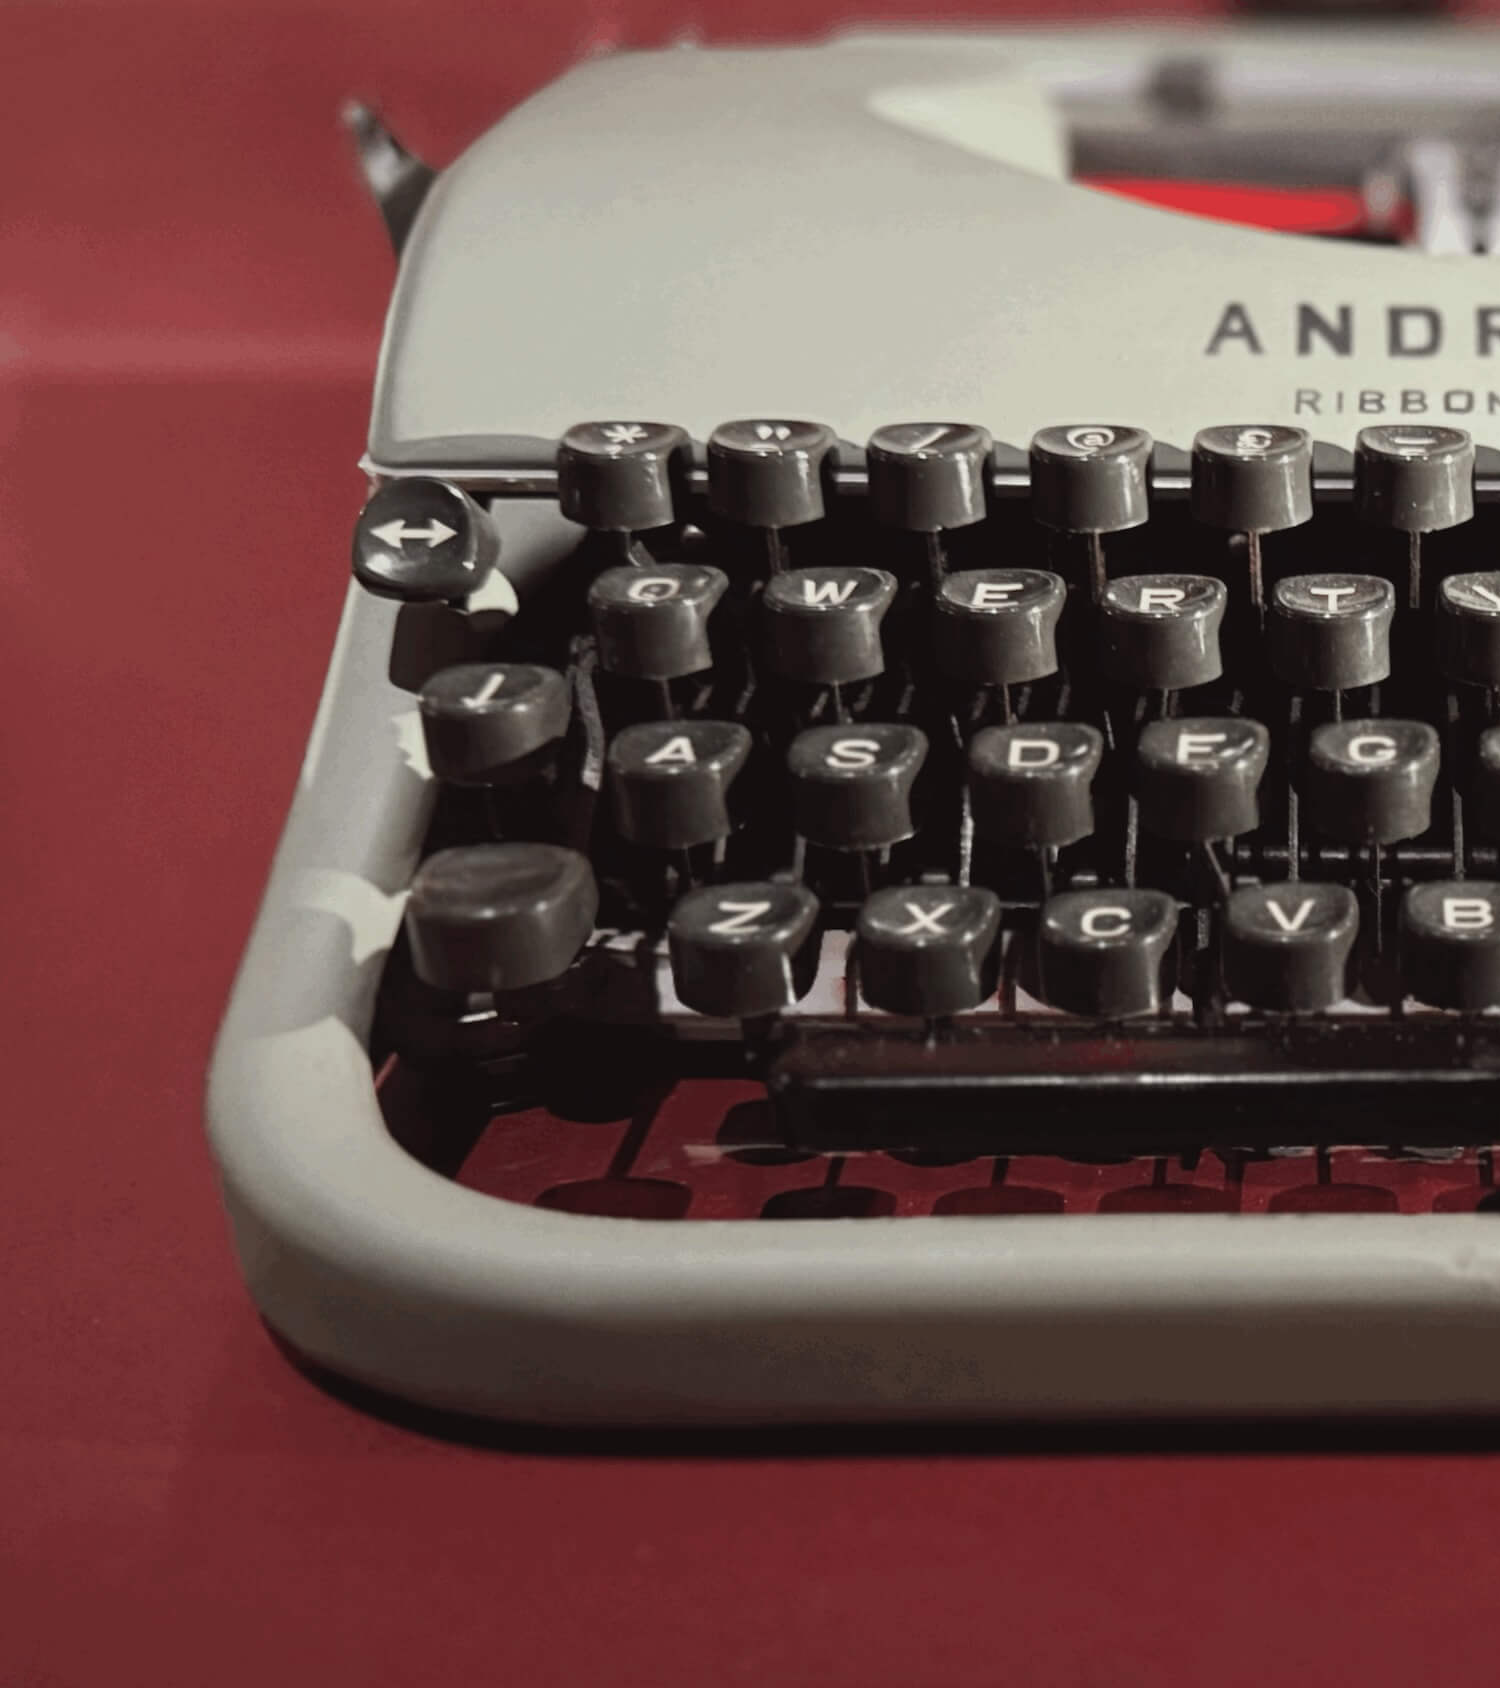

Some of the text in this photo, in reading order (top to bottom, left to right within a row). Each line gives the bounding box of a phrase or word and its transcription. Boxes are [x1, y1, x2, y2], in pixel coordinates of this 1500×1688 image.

[626, 577, 679, 600] Q
[802, 579, 857, 604] W
[972, 583, 1024, 607] E
[1139, 588, 1186, 611] R
[1310, 586, 1356, 611] T
[644, 736, 697, 764] A
[825, 739, 881, 768] S
[1008, 739, 1061, 767] D
[1177, 734, 1227, 764] F
[1347, 736, 1398, 763] G
[708, 901, 771, 934] Z
[900, 903, 955, 934] X
[1080, 907, 1132, 937] C
[1266, 900, 1315, 932] V
[1443, 899, 1494, 928] B
